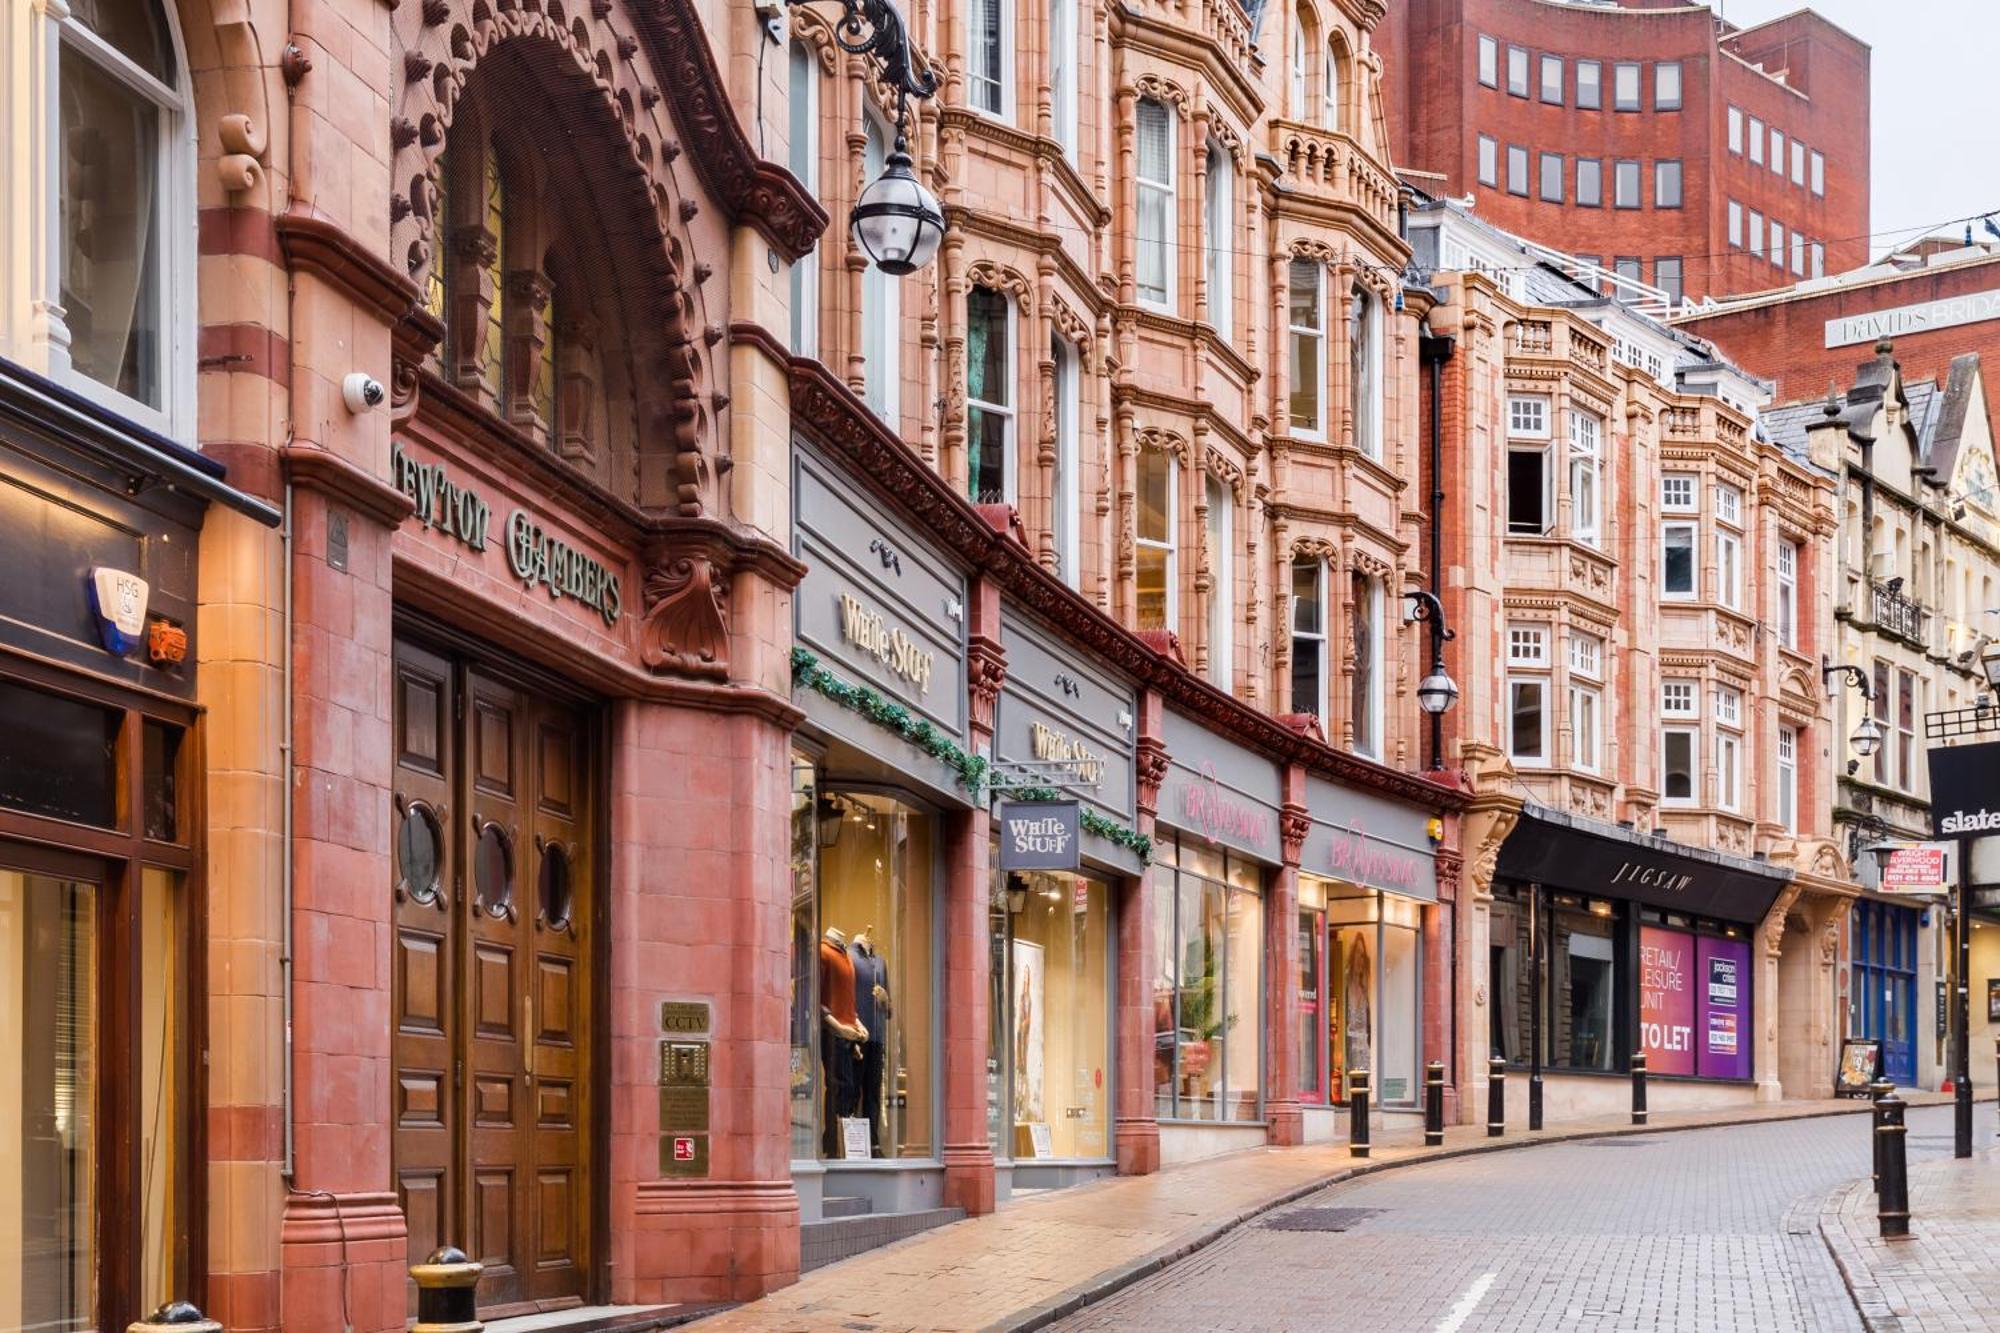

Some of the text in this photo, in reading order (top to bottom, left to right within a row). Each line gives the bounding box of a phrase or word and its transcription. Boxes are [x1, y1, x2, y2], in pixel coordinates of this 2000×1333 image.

[504, 508, 622, 626] CHAMBERS
[116, 576, 139, 598] HSG
[1611, 862, 1695, 892] JIGSAW
[664, 1016, 706, 1030] CCTV
[1641, 1022, 1660, 1050] TO
[1664, 1025, 1691, 1051] LET
